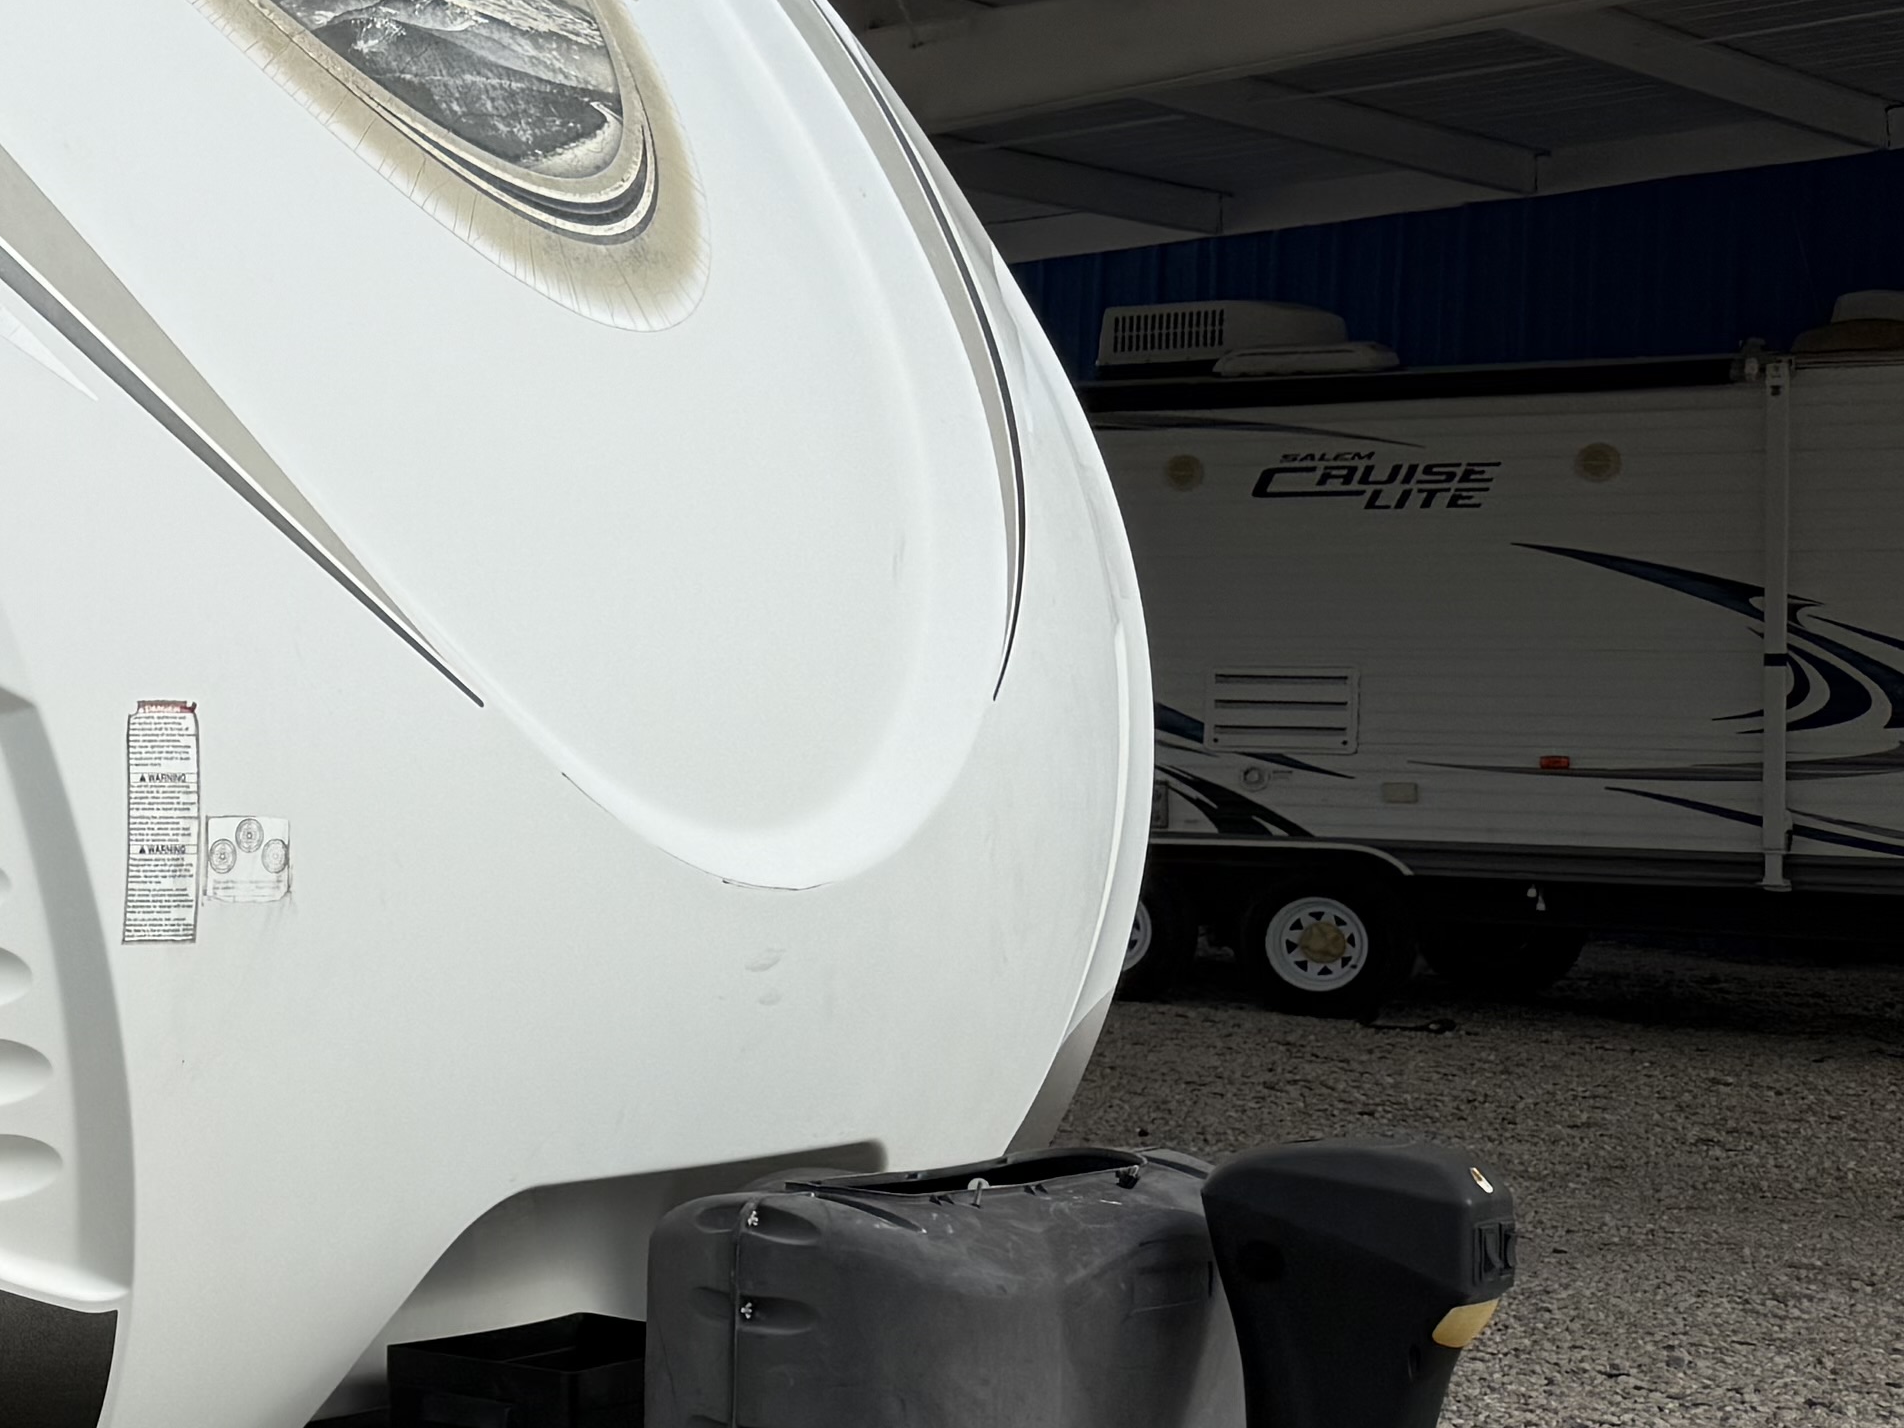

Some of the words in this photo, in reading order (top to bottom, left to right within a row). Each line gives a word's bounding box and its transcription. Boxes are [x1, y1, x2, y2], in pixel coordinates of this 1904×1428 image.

[1279, 451, 1376, 464] SALEM
[1250, 461, 1502, 498] CRUISE
[1363, 486, 1491, 510] LITE
